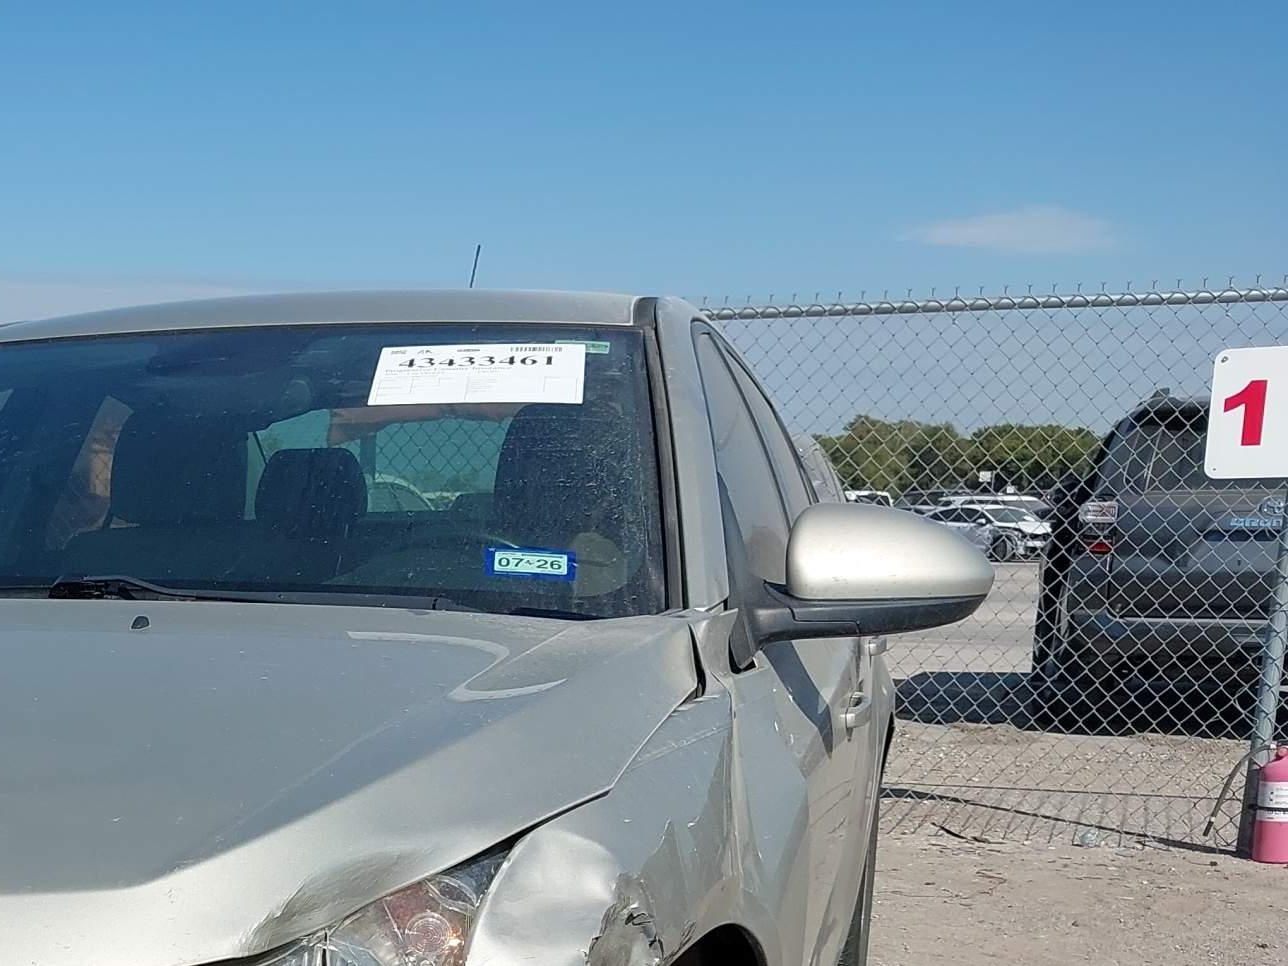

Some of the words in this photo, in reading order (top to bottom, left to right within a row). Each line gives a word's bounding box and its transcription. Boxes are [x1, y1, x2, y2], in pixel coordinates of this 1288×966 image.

[398, 355, 553, 368] 43433461
[1223, 379, 1268, 446] 1
[497, 557, 524, 568] 07
[536, 558, 562, 570] 26
